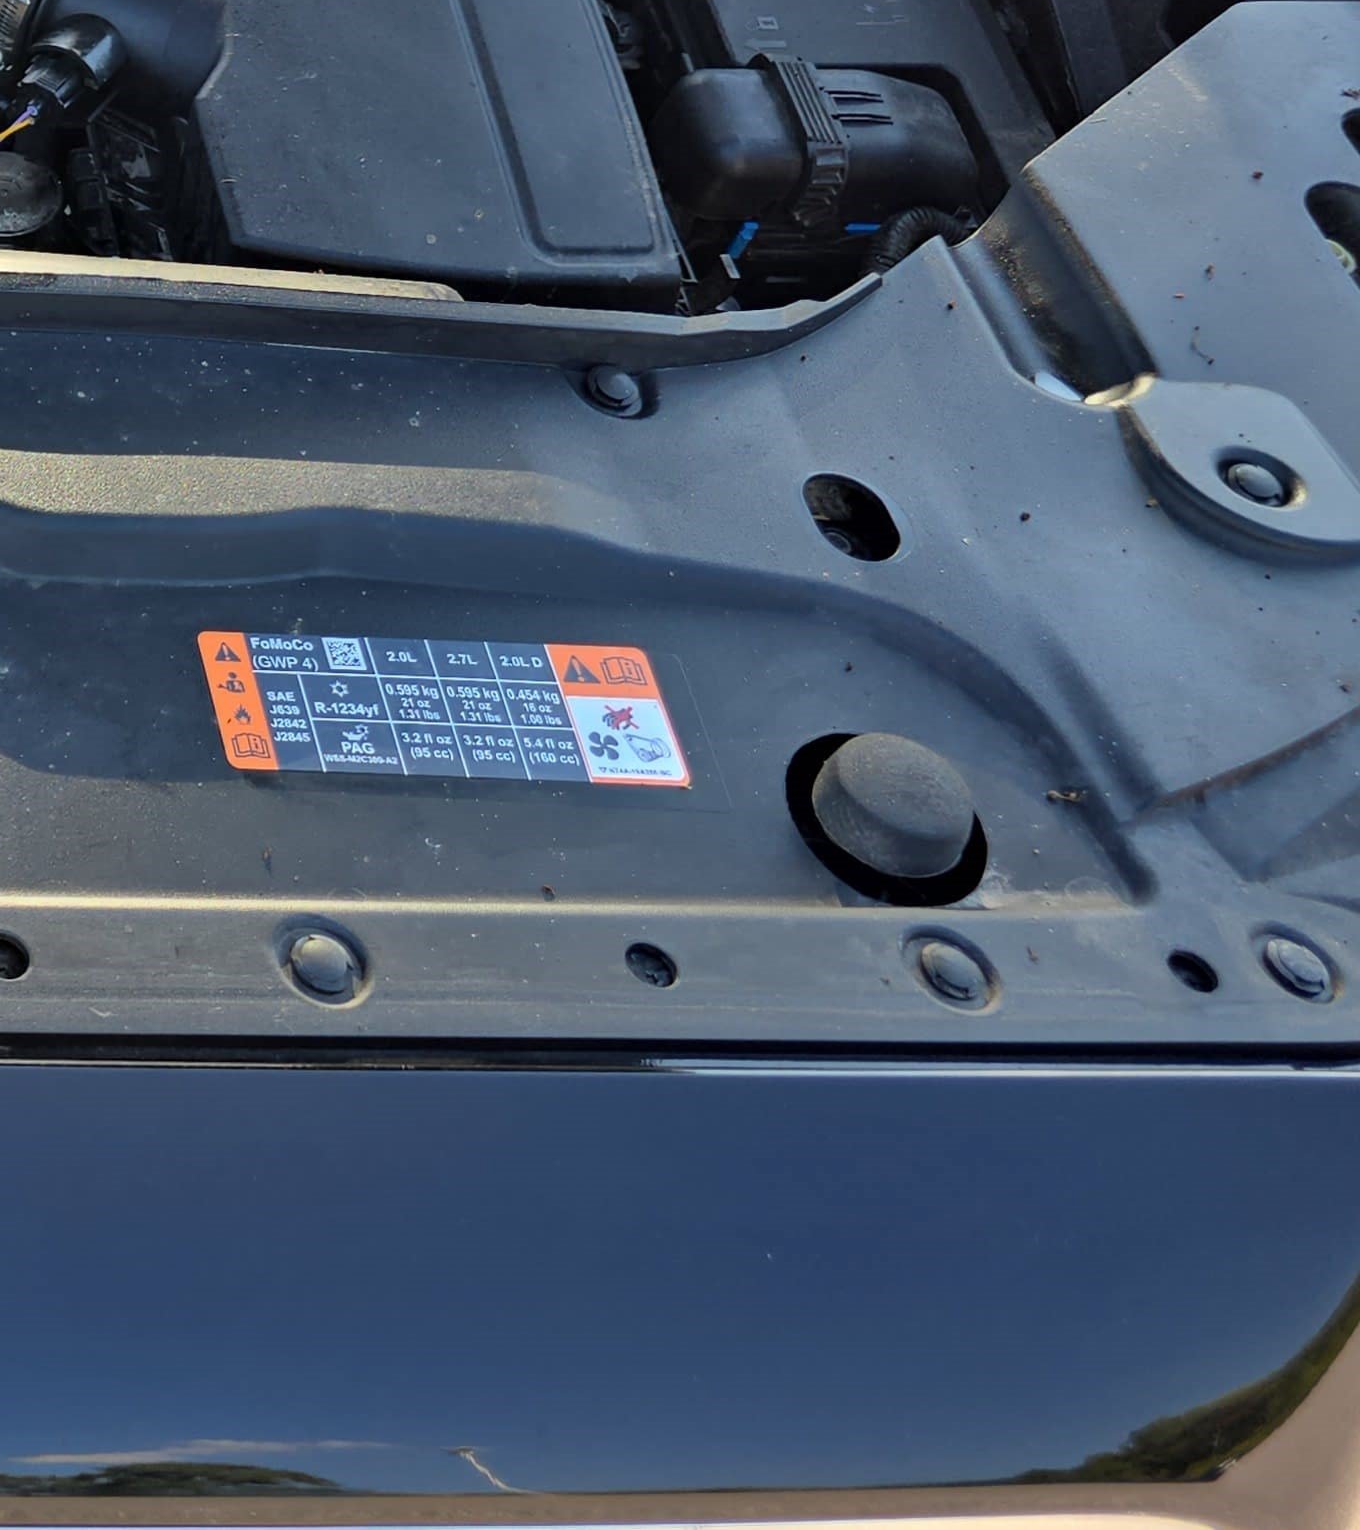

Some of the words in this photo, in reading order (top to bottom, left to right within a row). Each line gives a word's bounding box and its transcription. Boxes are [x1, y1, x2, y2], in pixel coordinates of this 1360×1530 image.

[249, 637, 314, 651] FoMoCo
[386, 651, 417, 663] 2.0L
[446, 653, 478, 665] 2.7L
[499, 655, 529, 668] 2.0L
[532, 657, 543, 668] D
[252, 655, 298, 670] (GWP
[302, 657, 319, 672] 4)
[266, 691, 296, 702] SAE
[385, 683, 419, 697] 0.595
[421, 685, 440, 700] kg
[446, 686, 480, 699] 0.595
[482, 688, 500, 702] kg
[507, 688, 542, 702] 0.454
[543, 691, 560, 705] kg
[401, 698, 415, 708] 21
[417, 700, 431, 708] oz
[462, 700, 475, 710] 21
[478, 702, 492, 711] oz
[523, 703, 536, 713] 16
[539, 705, 552, 713] oz
[314, 701, 380, 718] R-1234yf
[422, 710, 441, 720] lbs
[460, 711, 481, 722] 1.31
[483, 712, 502, 723] lbs
[544, 715, 562, 725] lbs
[270, 718, 307, 729] J2842
[274, 732, 311, 742] J2845
[401, 732, 422, 744] 3.2
[424, 733, 433, 744] fl
[436, 736, 453, 745] oz
[463, 735, 484, 746] 3.2
[498, 738, 514, 747] oz
[341, 741, 376, 755] PAG
[523, 738, 543, 749] 5.4
[558, 740, 574, 750] oz
[410, 746, 431, 760] (95
[433, 748, 454, 761] cc)
[472, 749, 493, 762] (95
[496, 750, 516, 764] cc)
[529, 751, 557, 765] (160
[559, 753, 580, 767] cc)
